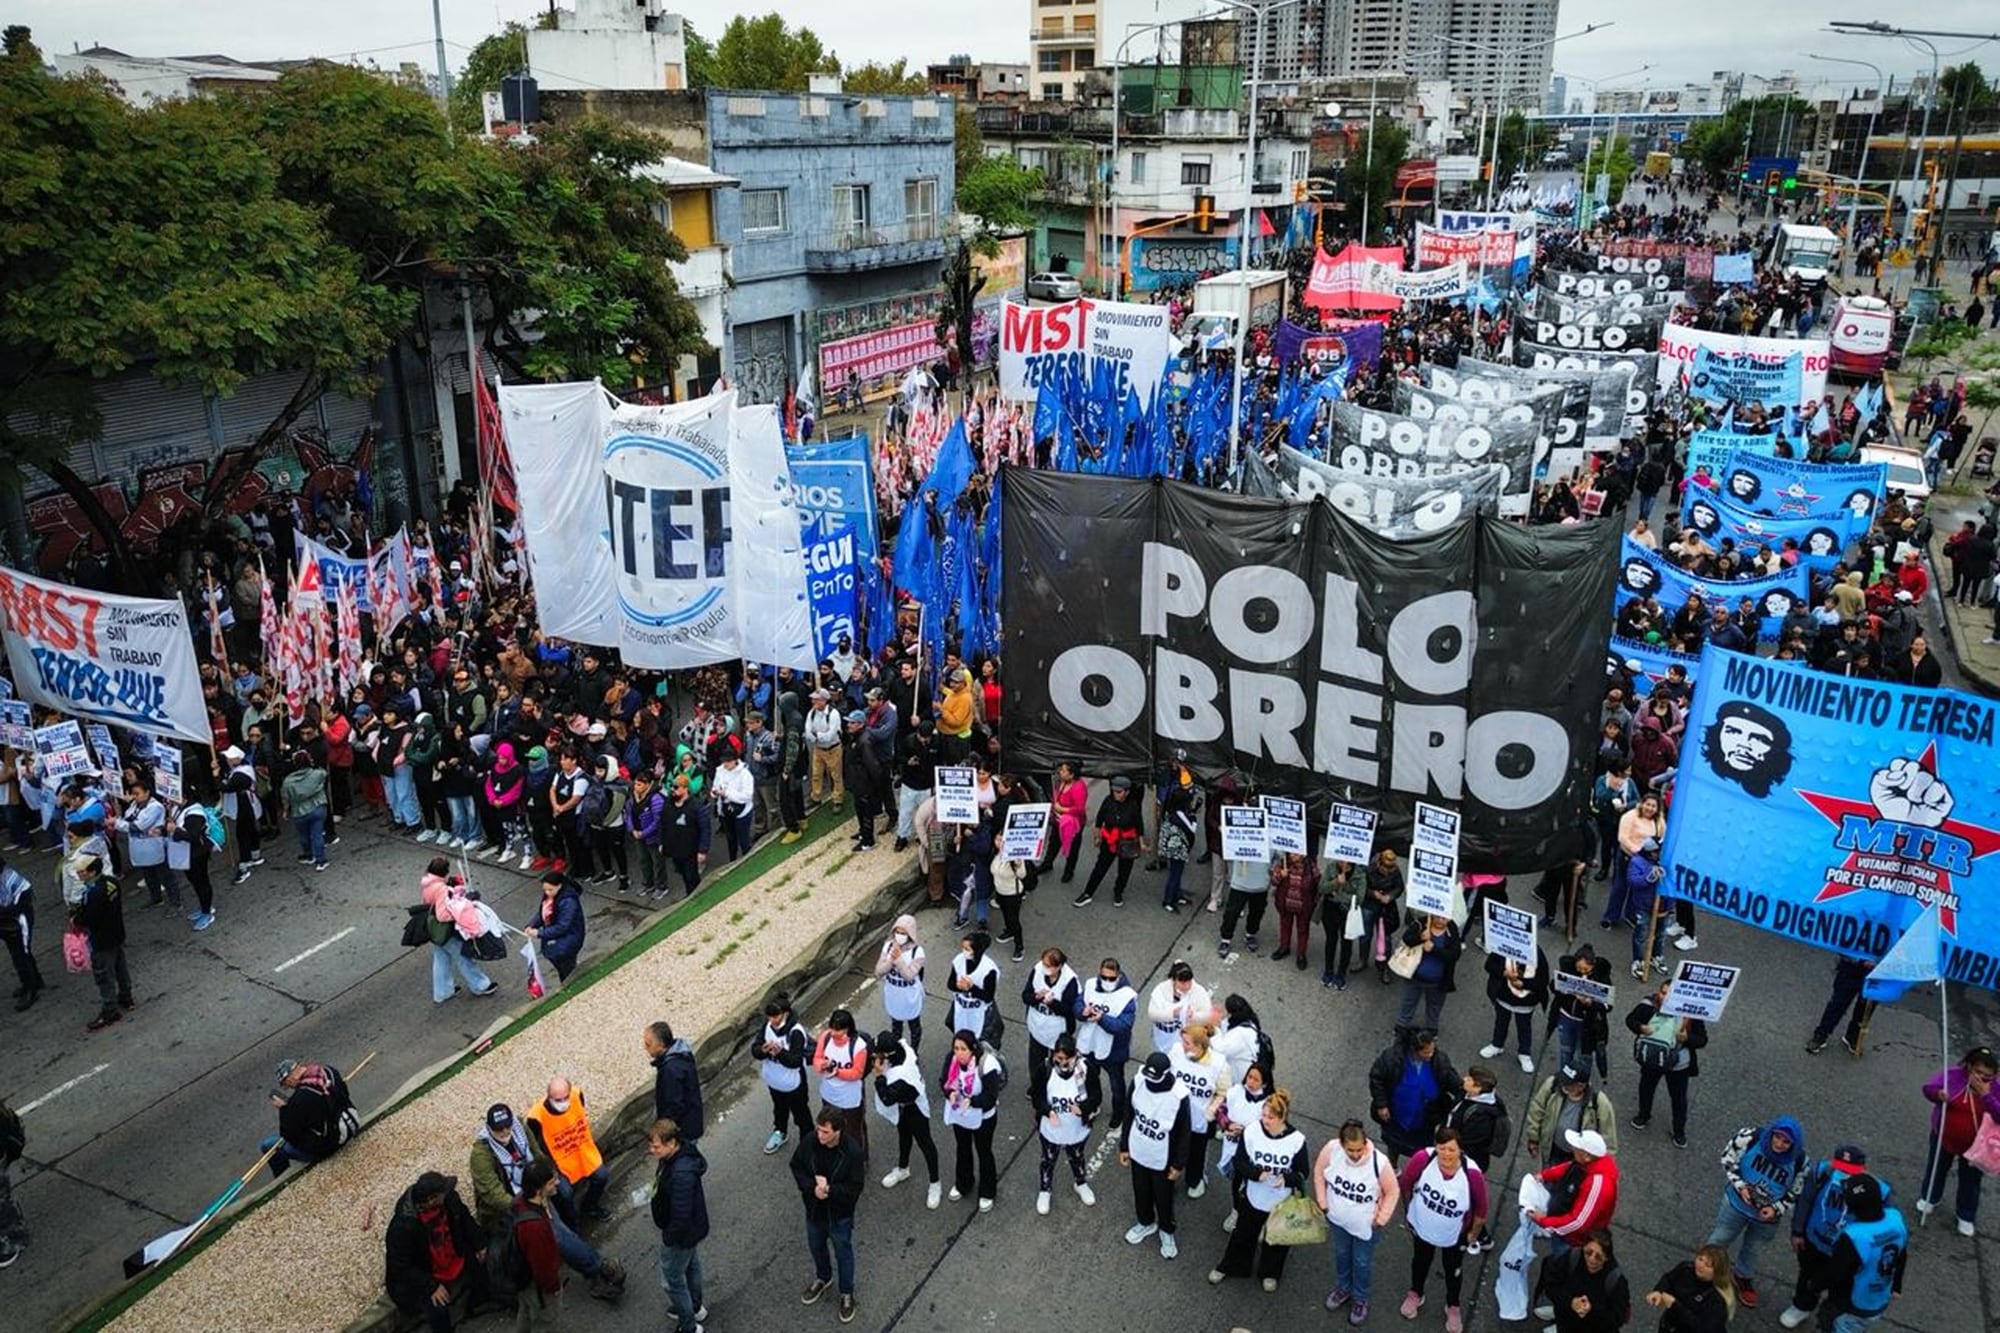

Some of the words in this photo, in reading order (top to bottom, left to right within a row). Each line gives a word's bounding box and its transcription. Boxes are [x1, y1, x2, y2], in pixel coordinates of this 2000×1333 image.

[1598, 255, 1661, 273] POLO
[1558, 274, 1632, 298] POLO
[1004, 298, 1096, 353] MST
[1096, 311, 1163, 327] MOVIMIENTO
[1094, 327, 1109, 340] SIN
[1537, 322, 1627, 349] POLO
[1093, 344, 1133, 360] TRABAJO
[1307, 348, 1340, 361] FOB
[1734, 357, 1747, 369] 12
[1360, 413, 1492, 458] POLO
[790, 484, 843, 508] RIOS
[812, 573, 854, 600] ento
[0, 571, 107, 658] MST
[108, 607, 180, 628] MOVIMIENTO
[680, 604, 728, 643] Popular
[1141, 541, 1476, 695] POLO
[106, 626, 128, 643] SIN
[815, 609, 854, 656] ta
[110, 647, 162, 667] TRABAJO
[1612, 634, 1663, 656] IMIENTO
[1665, 648, 1701, 663] TERES
[1723, 657, 1892, 728] MOVIMIENTO
[1898, 693, 1996, 748] TERESA
[1049, 645, 1570, 810] OBRERO
[1834, 814, 1974, 877] MTR
[1857, 856, 1902, 873] VOTAMOS
[1902, 863, 1938, 884] LUCHAR
[1826, 868, 1851, 886] POR
[1851, 872, 1867, 888] EL
[1869, 875, 1914, 897] CAMBIO
[1916, 882, 1961, 912] SOCIAL
[1674, 864, 1770, 923] TRABAJO
[1773, 900, 1891, 954] DIGNIDAD
[1942, 942, 2000, 988] MBI
[1176, 1070, 1207, 1087] POLO
[1254, 1151, 1290, 1165] POLO
[1750, 1153, 1790, 1186] MTR
[1327, 1180, 1373, 1204] ERO
[1334, 1175, 1366, 1193] POLO
[1422, 1183, 1457, 1209] POLO
[1414, 1187, 1463, 1218] RERO
